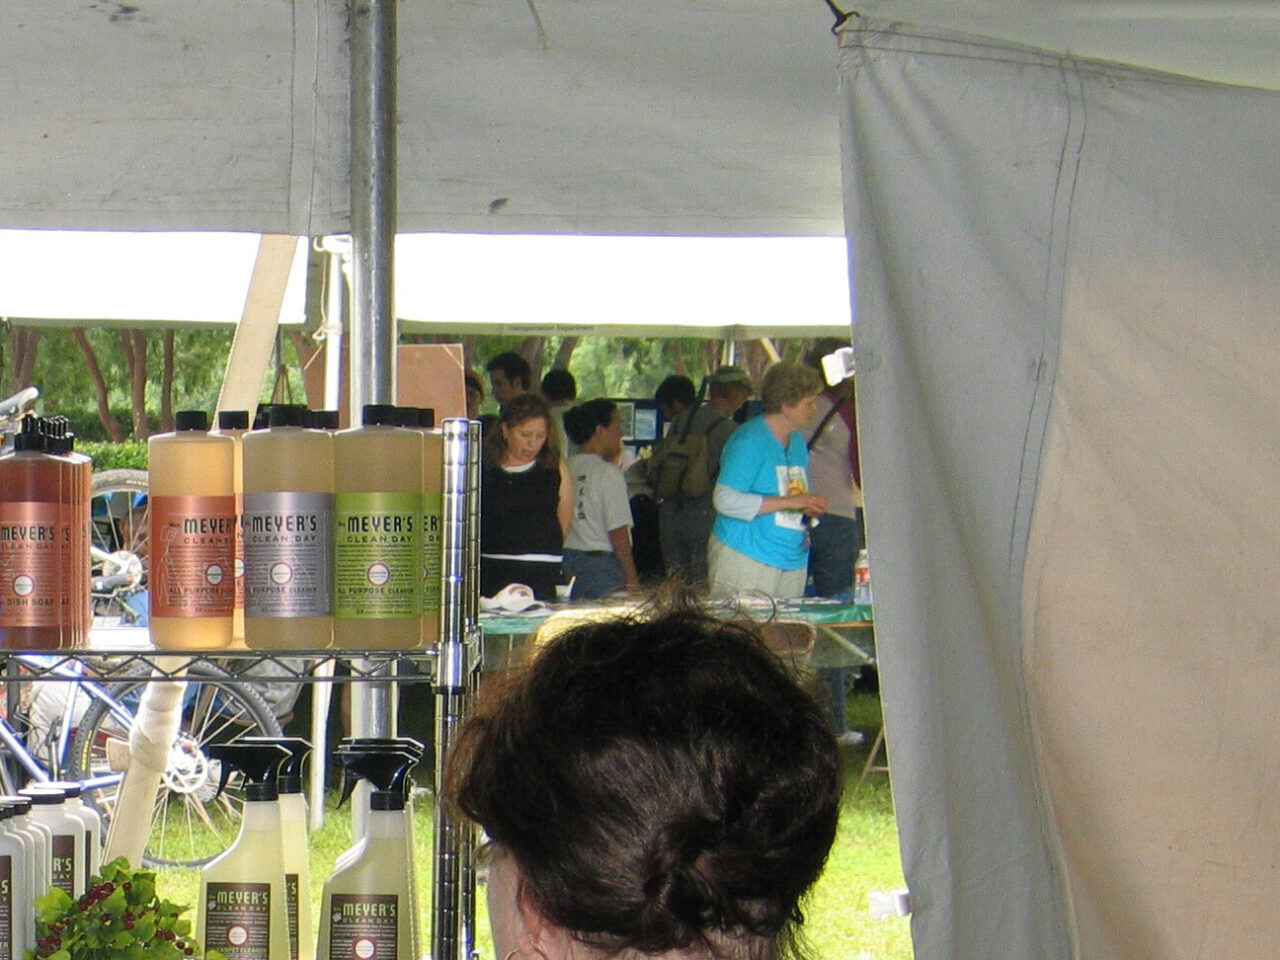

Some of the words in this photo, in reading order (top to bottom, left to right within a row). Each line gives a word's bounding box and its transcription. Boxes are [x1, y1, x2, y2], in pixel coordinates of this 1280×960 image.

[252, 515, 317, 533] MEYER'S
[347, 515, 413, 533] MEYER'S
[1, 526, 55, 541] MEYER'S
[252, 535, 289, 543] CLEAN
[347, 535, 388, 543] CLEAN
[391, 535, 413, 543] DAY
[217, 891, 268, 904] MEYER'S
[342, 903, 396, 917] MEYER'S
